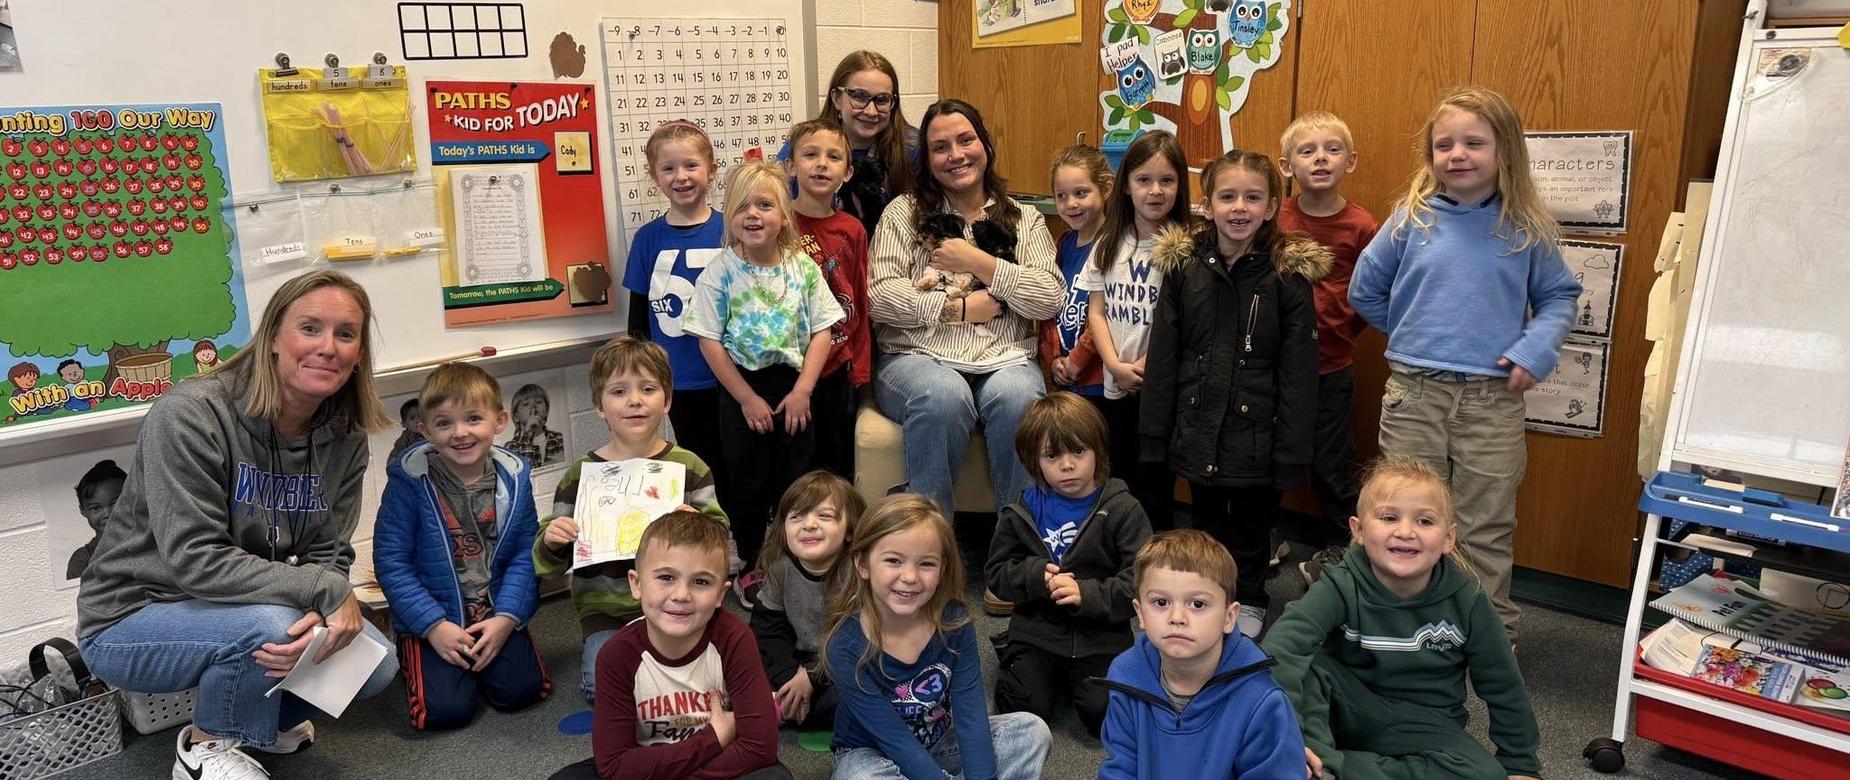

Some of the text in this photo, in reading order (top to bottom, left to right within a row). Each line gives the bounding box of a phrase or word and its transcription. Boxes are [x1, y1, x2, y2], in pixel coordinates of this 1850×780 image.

[1233, 20, 1260, 36] Tinsley
[618, 49, 786, 60] 1 2 3 4 5 6 7 8 9 10
[1105, 38, 1133, 58] I pad
[1107, 52, 1137, 72] Helper
[1191, 51, 1214, 62] Blake
[616, 70, 788, 84] 11 12 13 14 15 16 17 18 19 20
[272, 82, 307, 91] hundreds
[435, 92, 511, 110] PATHS
[618, 92, 789, 108] 21 22 23 24 25 26 27 28 29 30
[119, 110, 161, 126] Our
[166, 109, 213, 132] Way
[454, 93, 580, 132] KID FOR TODAY
[620, 123, 629, 132] 31
[639, 122, 649, 131] 32
[714, 118, 723, 127] 36
[731, 117, 740, 126] 37
[748, 116, 757, 125] 38
[765, 115, 774, 124] 39
[780, 114, 791, 122] 40
[438, 145, 535, 157] Today's PATHS Kid is
[622, 136, 775, 156] 41 46 47 48 49
[626, 166, 635, 175] 51
[717, 159, 726, 167] 56
[629, 188, 657, 199] 61 62
[631, 212, 641, 221] 71
[414, 230, 432, 238] Ones
[266, 245, 301, 256] Hundreds
[1128, 260, 1152, 283] W
[449, 292, 484, 300] Tomorrow,
[652, 298, 672, 312] SIX
[10, 379, 172, 412] With an Apple
